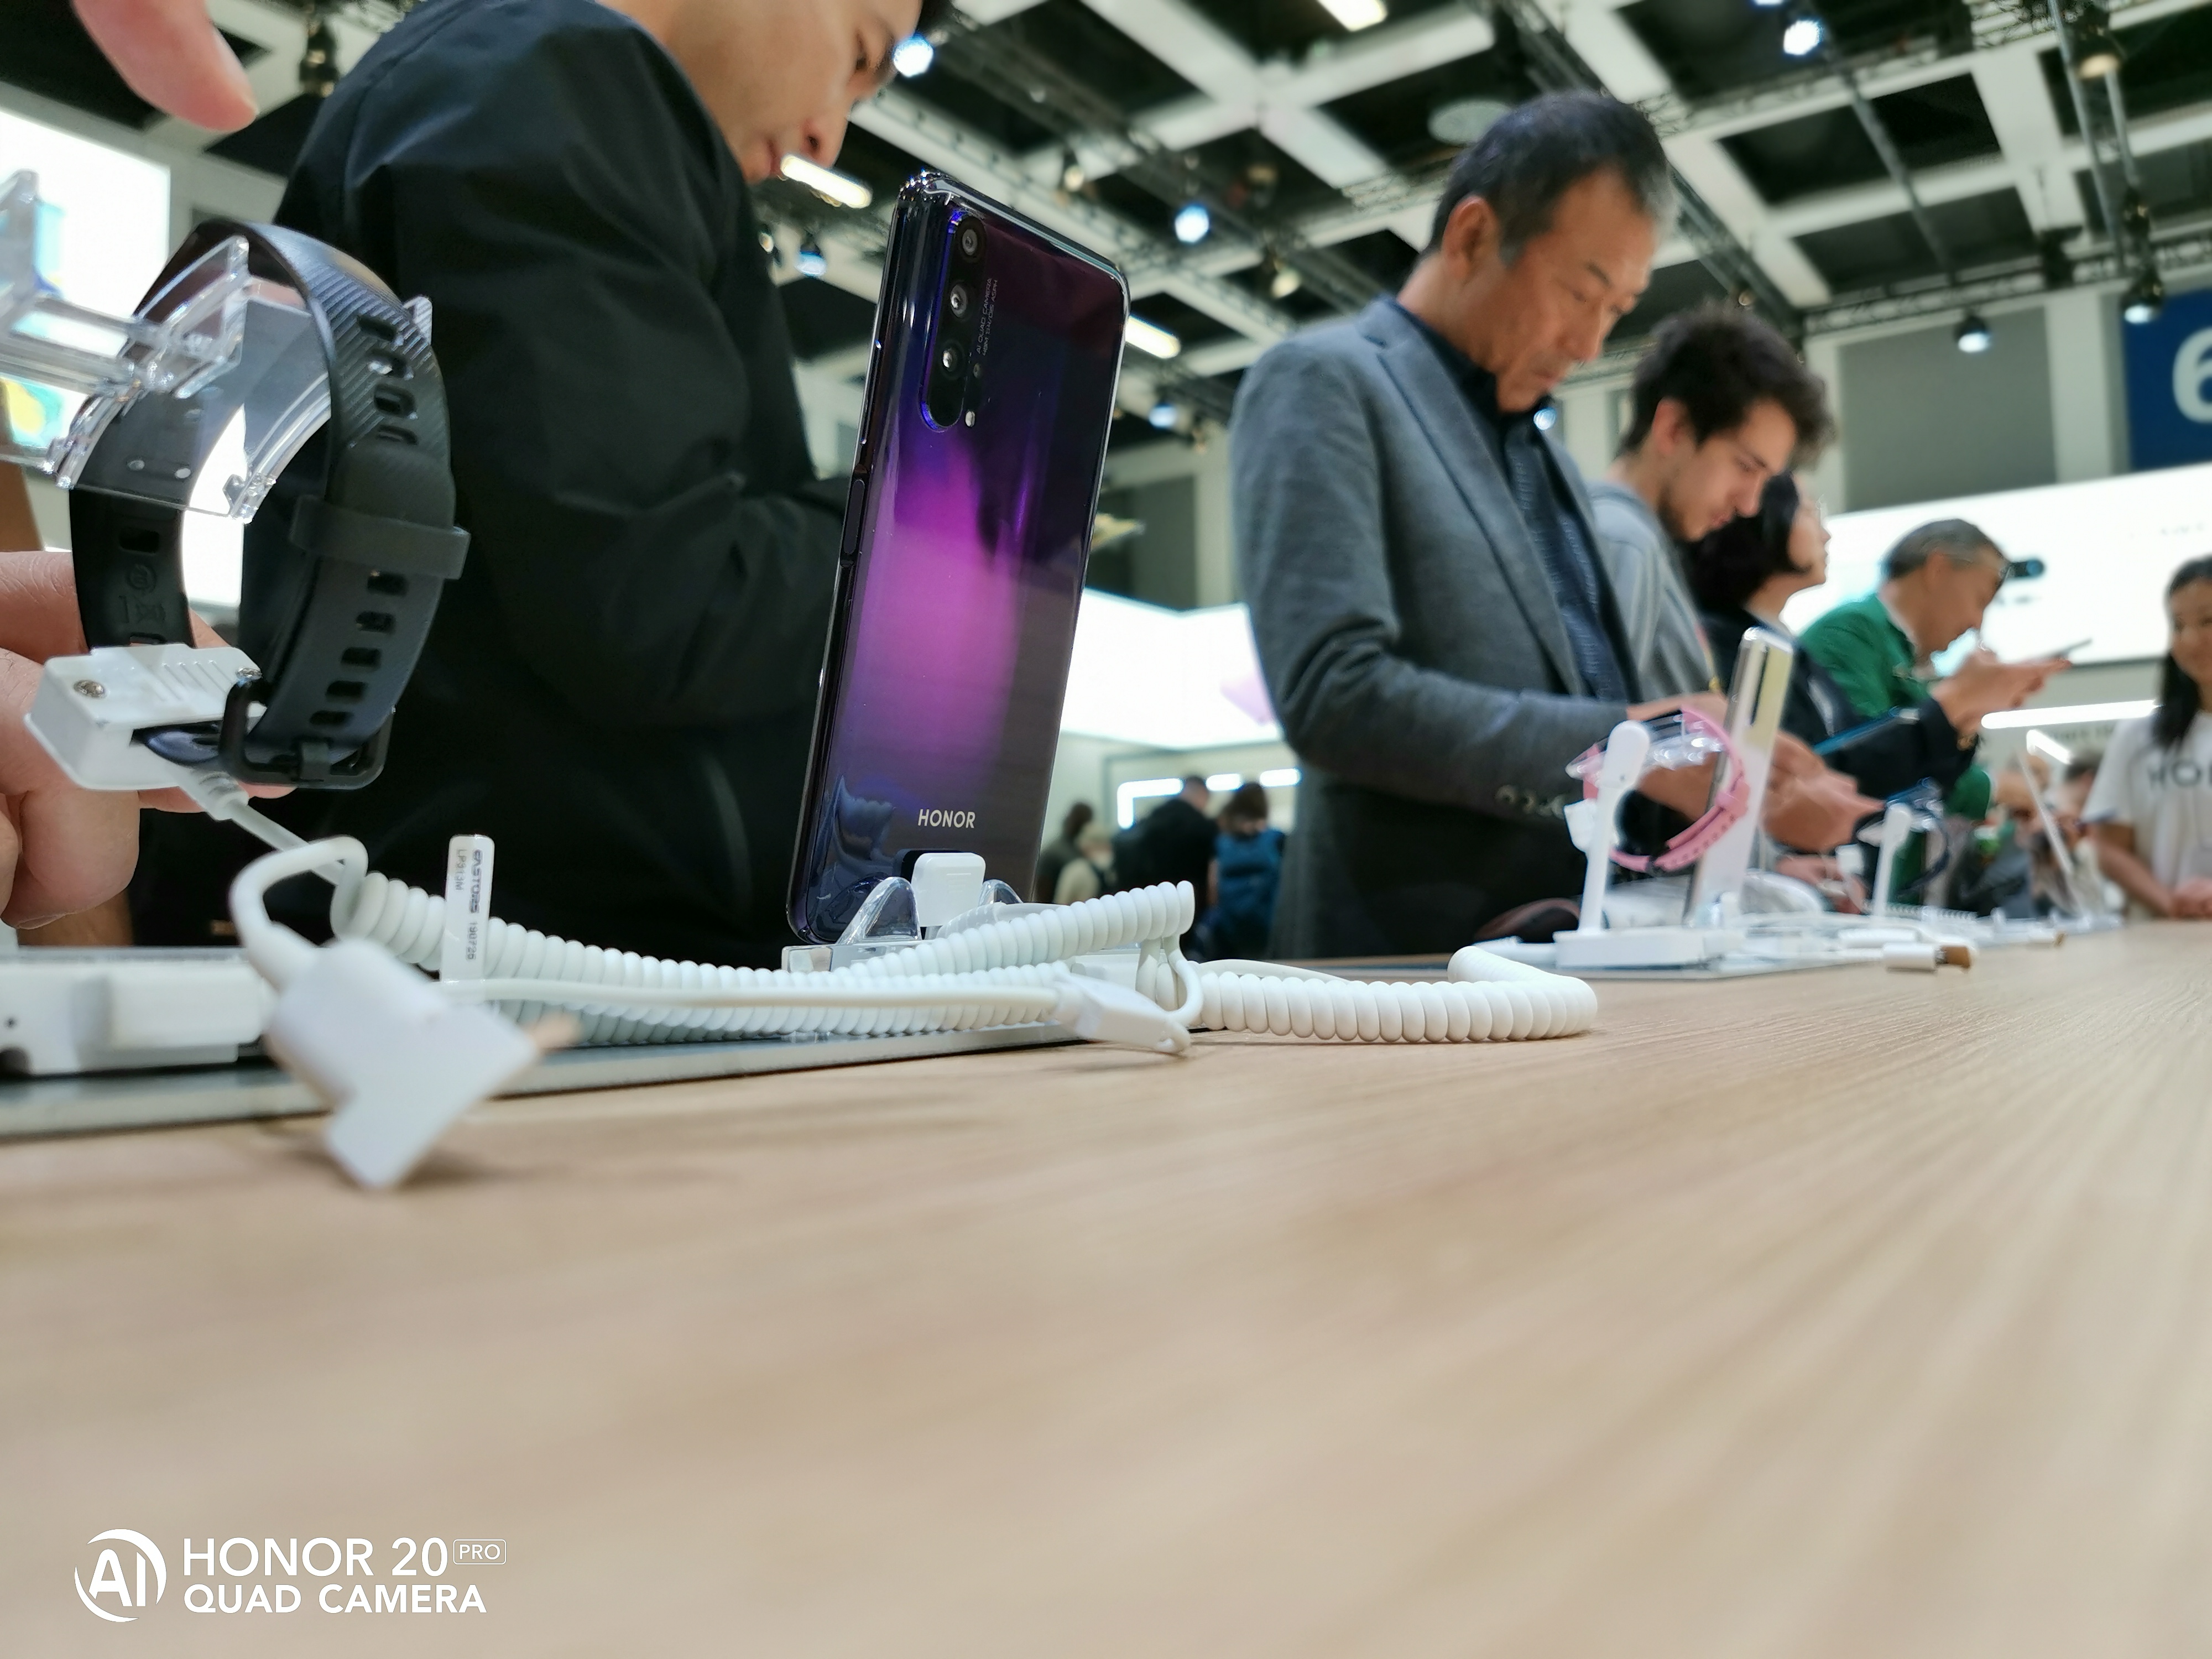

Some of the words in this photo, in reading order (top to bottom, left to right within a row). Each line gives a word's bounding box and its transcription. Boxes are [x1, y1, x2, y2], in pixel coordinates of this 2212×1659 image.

[982, 278, 993, 315] CAMERA
[978, 317, 987, 343] QUAD
[2172, 326, 2212, 424] 6
[2148, 759, 2212, 789] HO
[917, 808, 975, 829] HONOR
